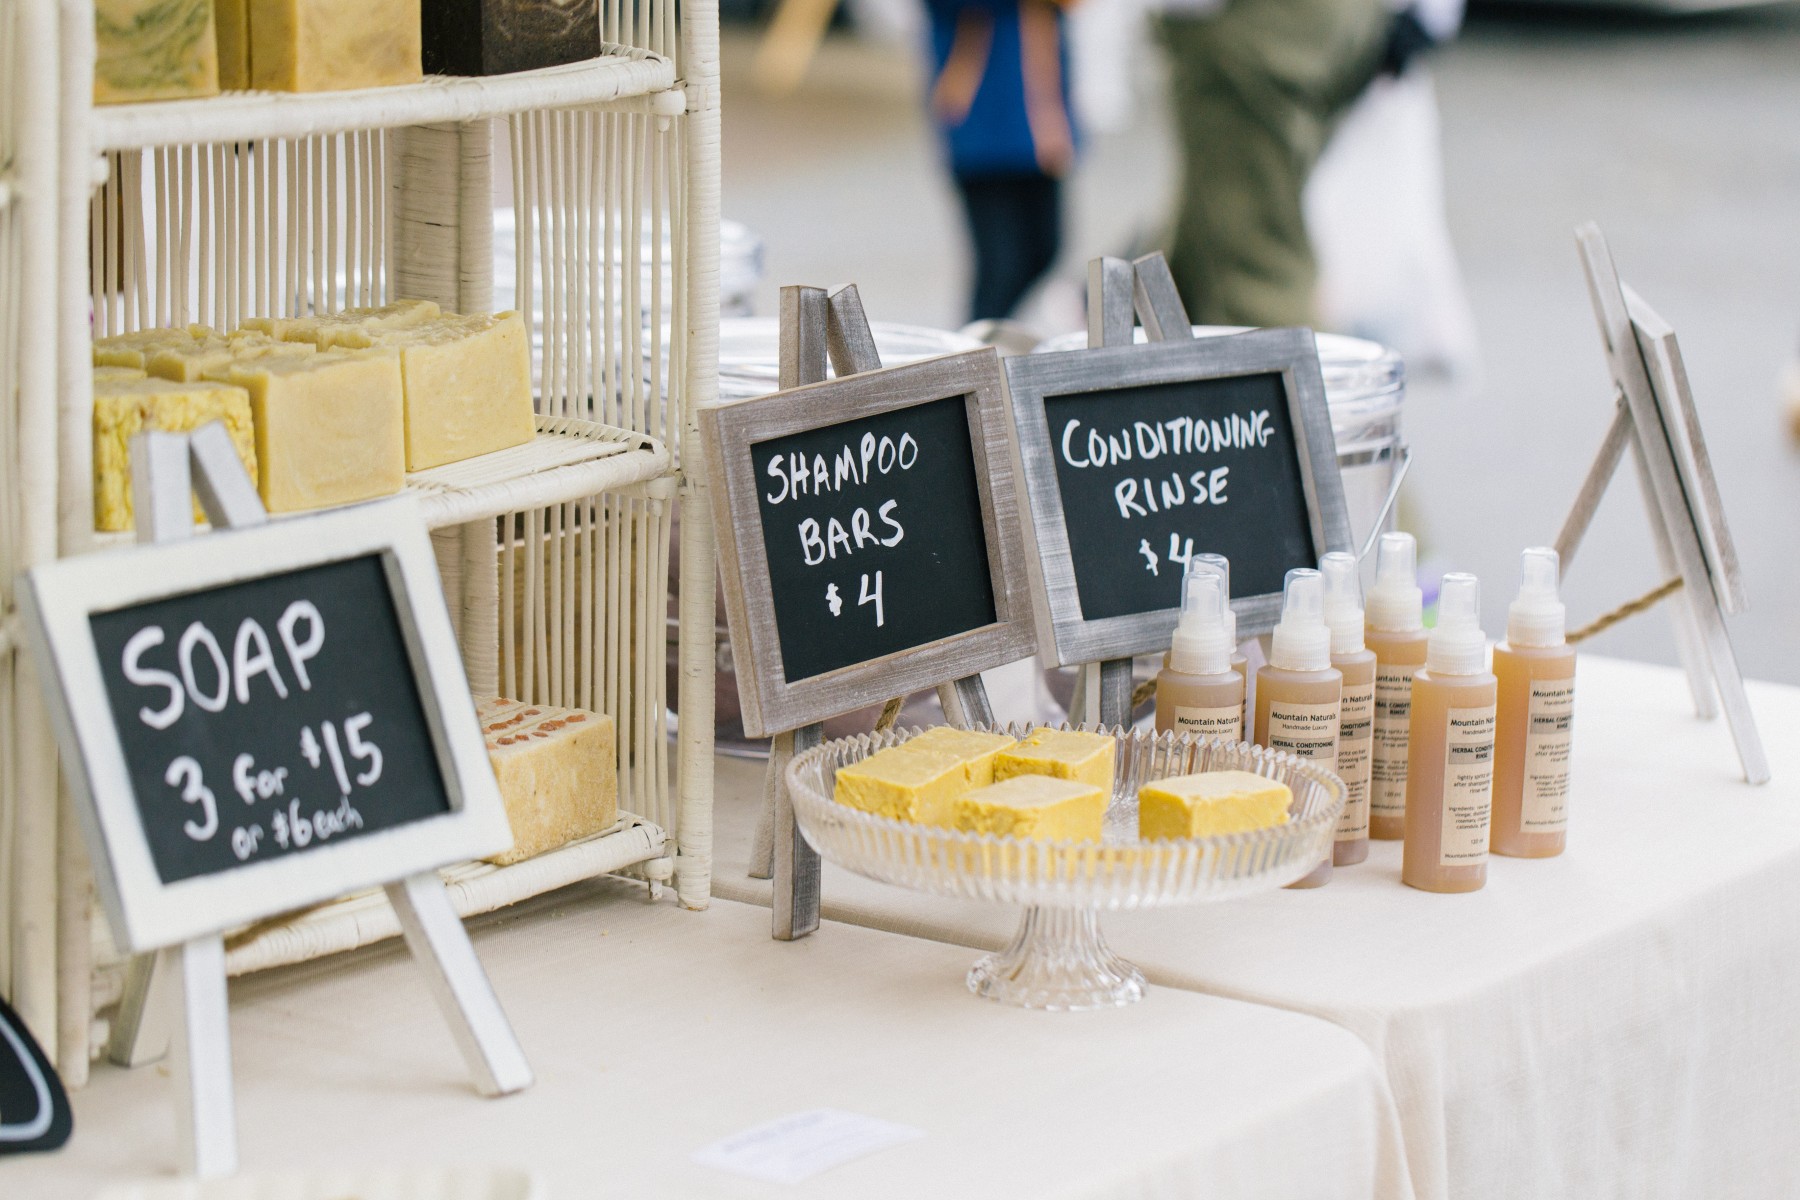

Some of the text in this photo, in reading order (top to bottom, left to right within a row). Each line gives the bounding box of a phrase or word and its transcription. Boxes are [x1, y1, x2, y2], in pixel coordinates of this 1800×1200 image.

[1061, 409, 1275, 468] CONDITIONING
[767, 431, 919, 505] SHAMPOO
[1114, 466, 1230, 519] RINSE
[798, 499, 904, 566] BARS
[122, 600, 325, 730] SOAP
[1532, 689, 1566, 697] Mountain
[1178, 716, 1215, 726] Mountain
[1271, 711, 1308, 722] Mountain
[1282, 723, 1311, 731] Handmade
[1340, 720, 1371, 730] ONDITIONING
[1450, 718, 1485, 727] Mountain
[1272, 739, 1333, 748] HERBAL CONDITIONING
[165, 711, 383, 841] 3 for $15
[232, 825, 264, 861] or
